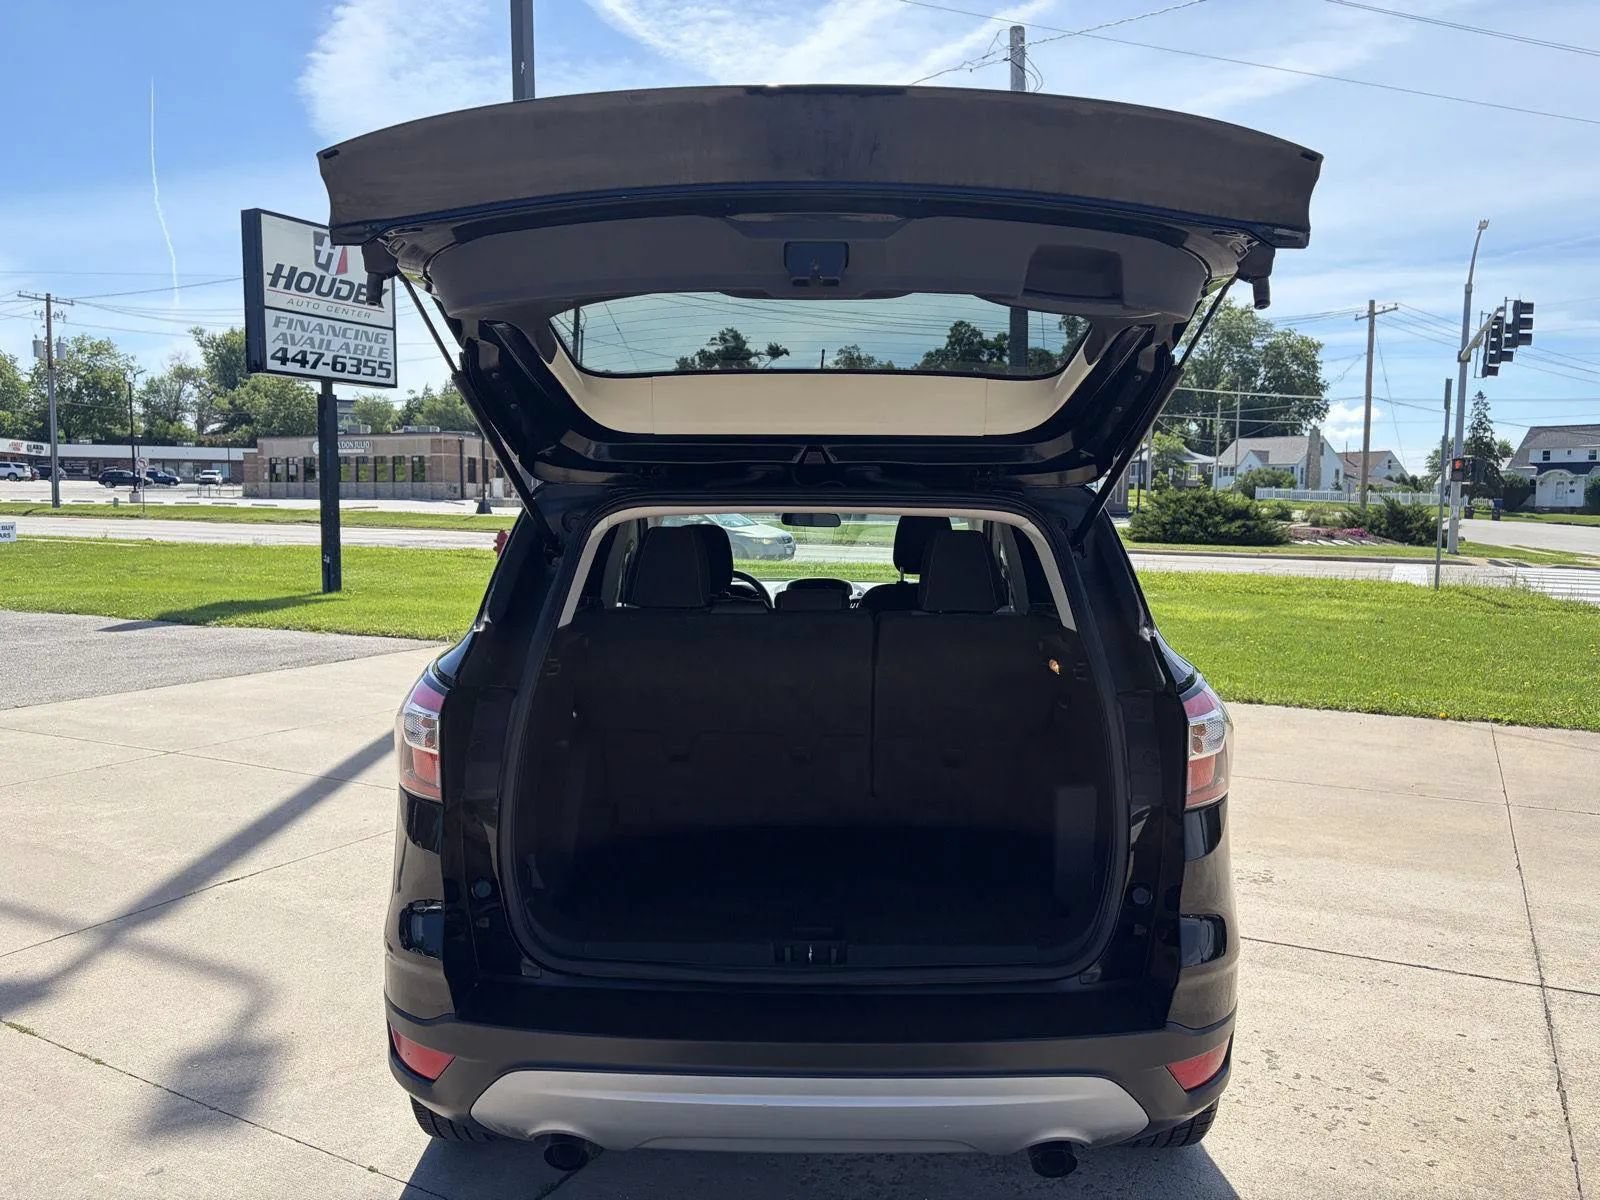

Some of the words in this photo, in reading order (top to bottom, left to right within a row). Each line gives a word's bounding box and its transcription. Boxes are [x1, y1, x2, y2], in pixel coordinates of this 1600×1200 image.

[287, 298, 320, 310] AUTO
[326, 305, 371, 319] CENTER
[272, 315, 388, 345] FINANCING
[271, 332, 389, 360] AVAILABLE
[270, 347, 392, 379] 447-6355
